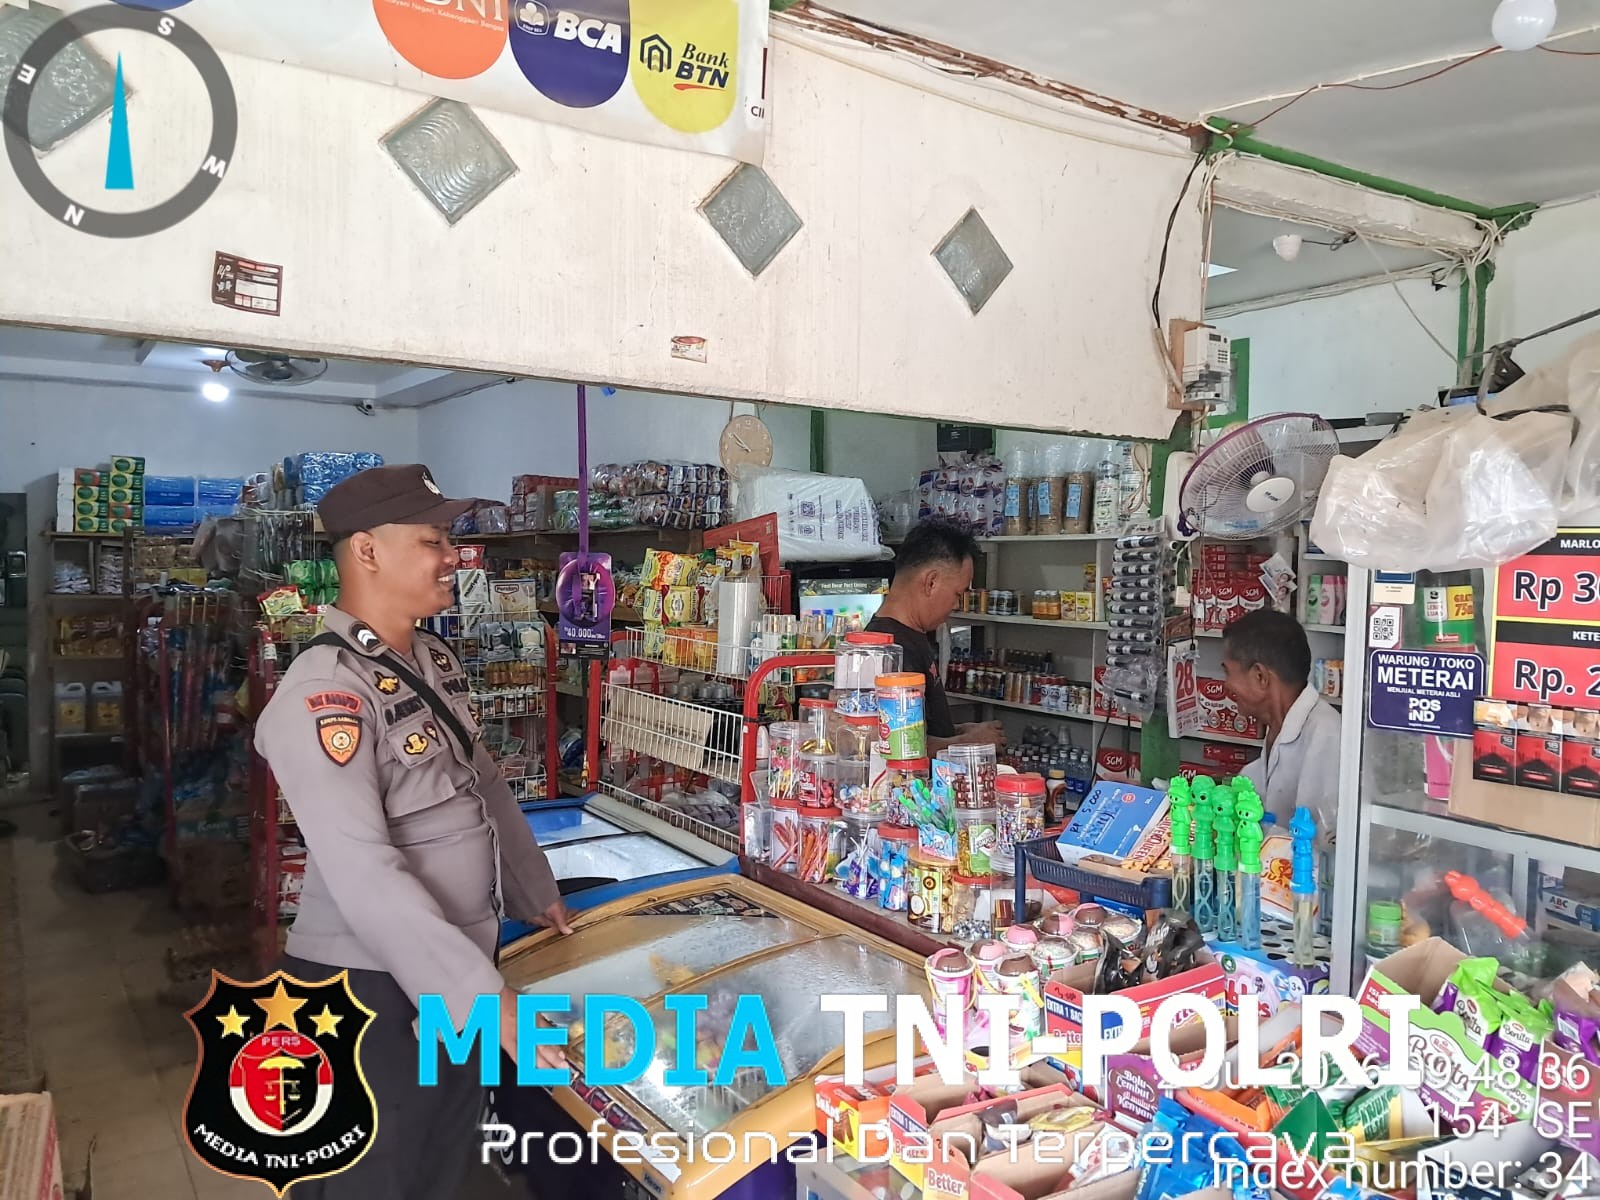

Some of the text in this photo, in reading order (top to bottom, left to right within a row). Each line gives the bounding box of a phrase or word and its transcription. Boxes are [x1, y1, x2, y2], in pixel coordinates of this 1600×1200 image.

[554, 10, 622, 54] BCA
[682, 42, 730, 68] Bank
[675, 60, 730, 88] BTN
[1514, 570, 1600, 612] Rp 3
[1378, 653, 1430, 668] WARUNG
[1439, 657, 1475, 670] TOKO
[1176, 660, 1194, 699] 28
[1206, 684, 1223, 694] SGM
[1377, 665, 1474, 691] METERAI
[1514, 658, 1576, 702] Rp.
[1408, 697, 1442, 712] POS
[1416, 689, 1445, 697] METERAI
[1106, 756, 1123, 766] SGM
[1550, 895, 1569, 909] ABC
[1123, 1069, 1148, 1089] Bolu
[1116, 1093, 1154, 1120] Kenyan
[928, 1168, 963, 1196] Better
